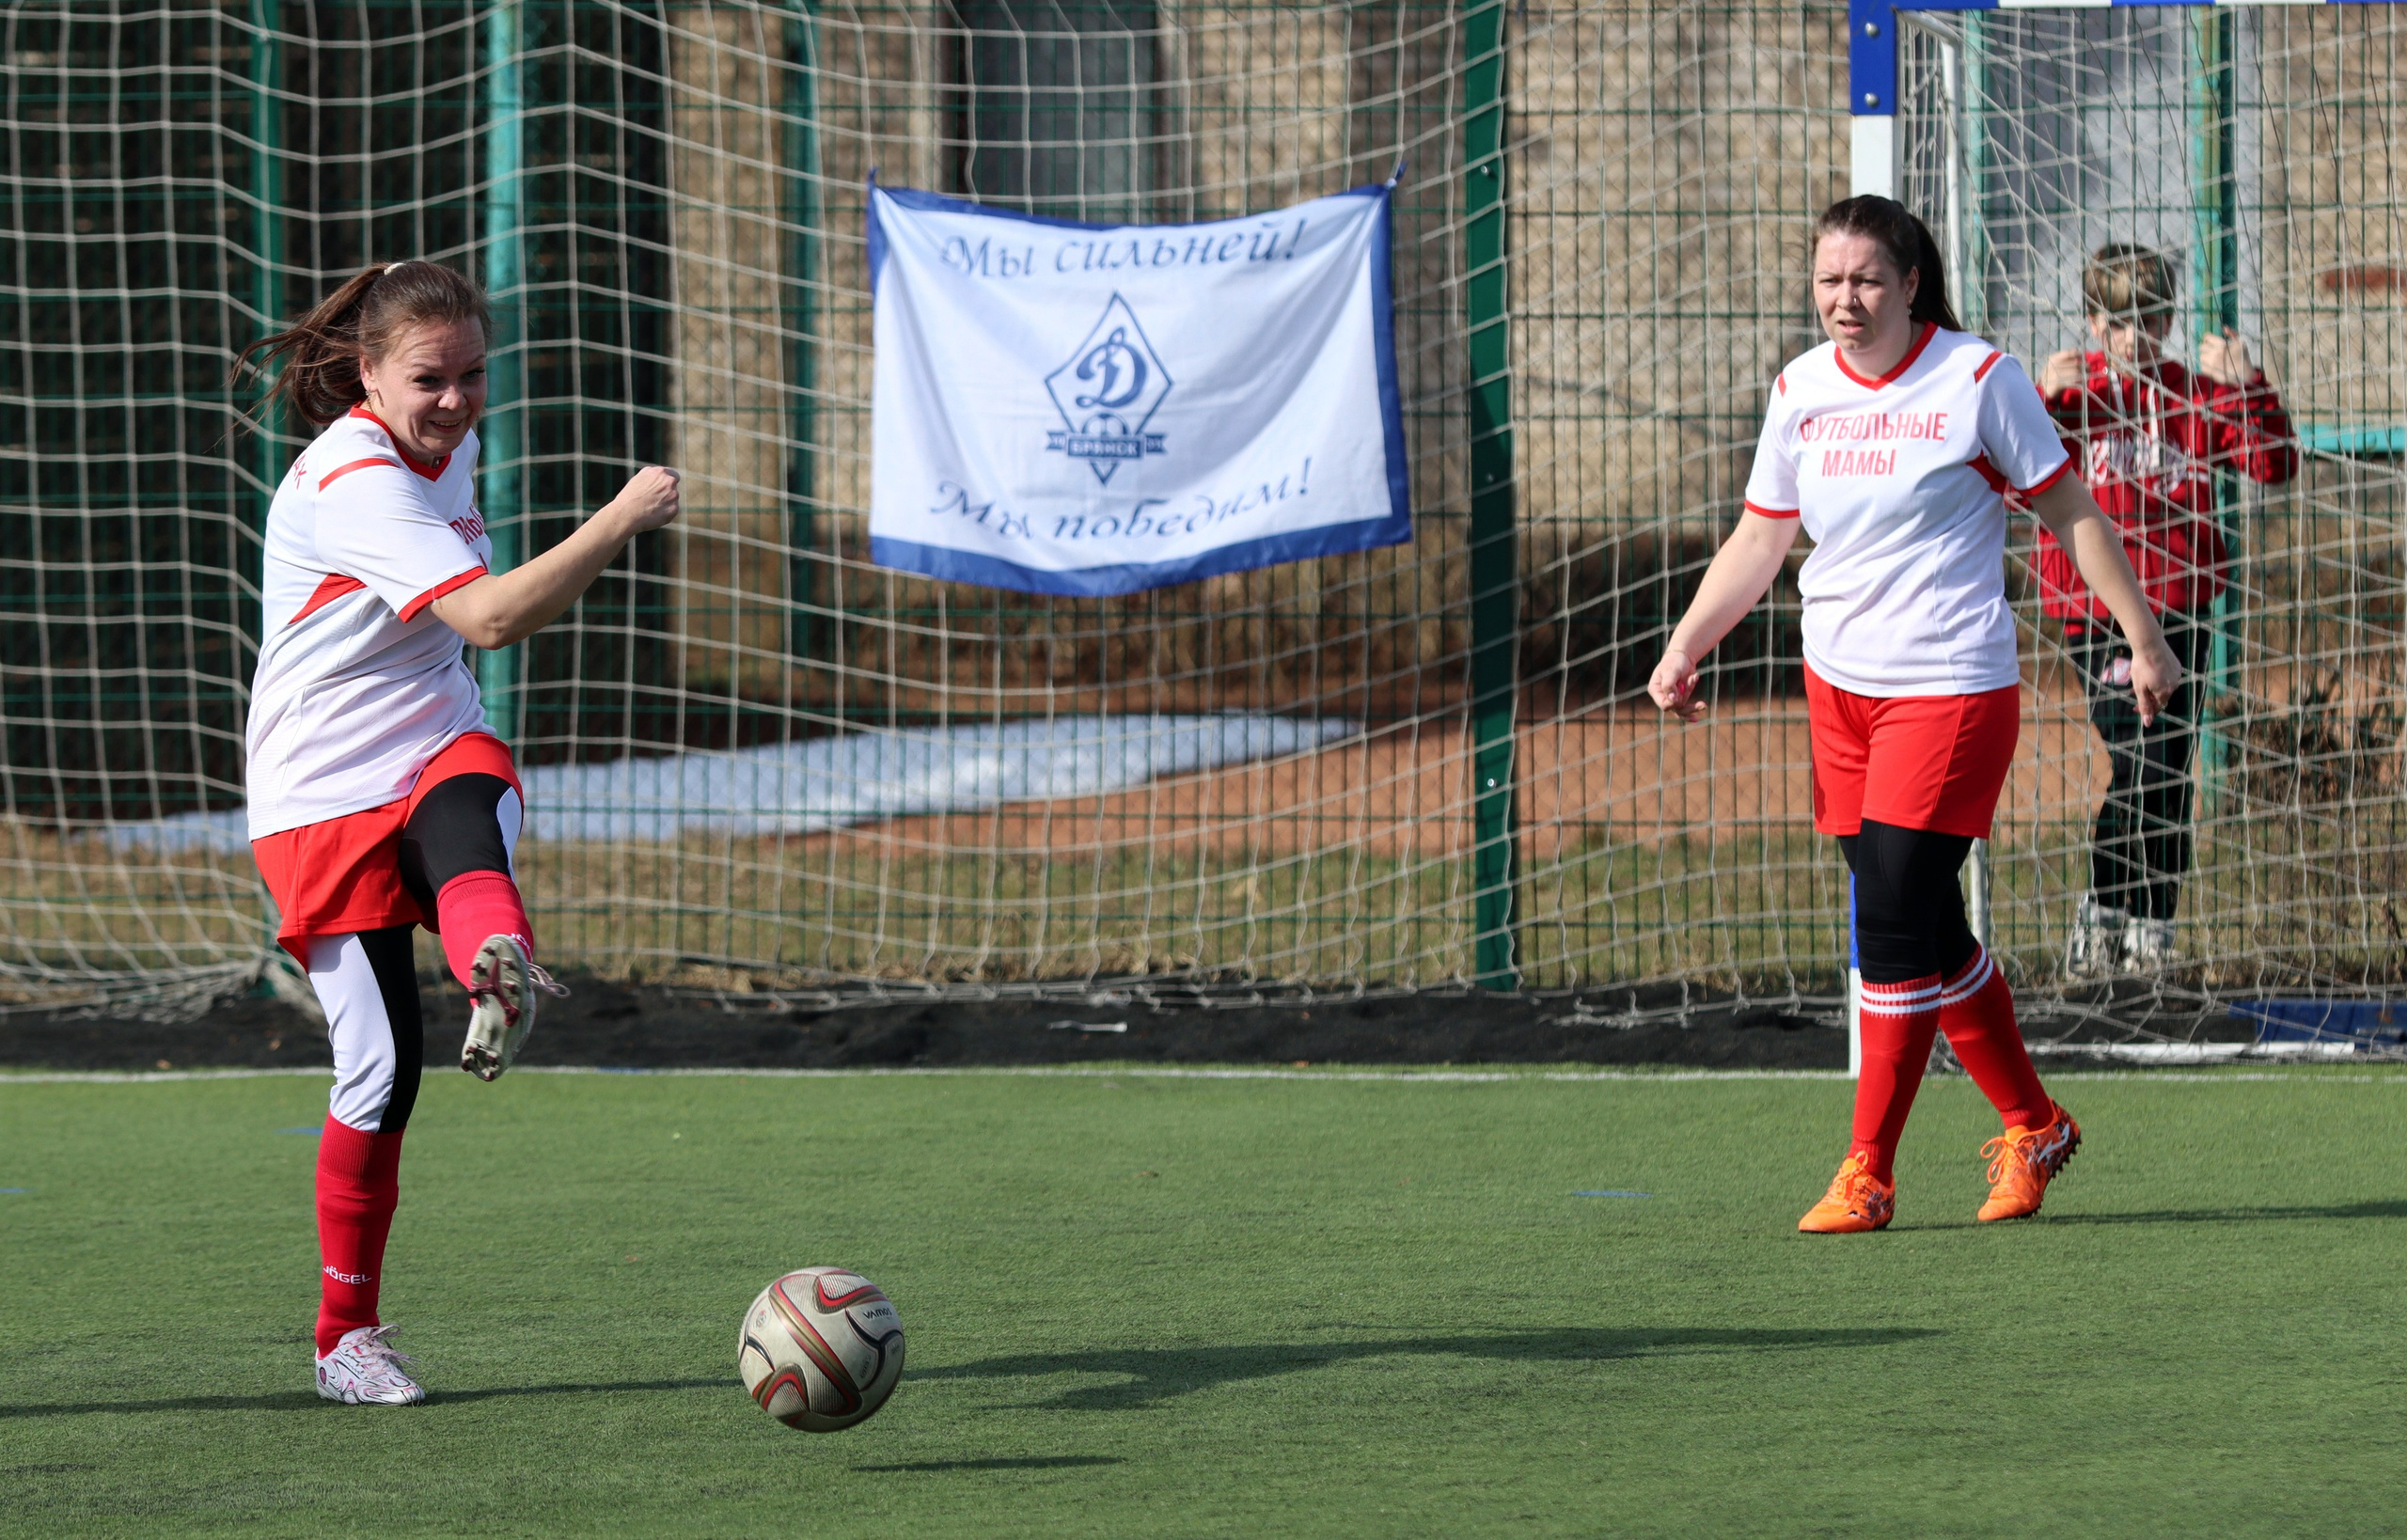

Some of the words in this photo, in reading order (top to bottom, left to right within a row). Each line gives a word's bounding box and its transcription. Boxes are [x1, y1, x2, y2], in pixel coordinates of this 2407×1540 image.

[941, 235, 1033, 276] Мы
[1056, 218, 1307, 273] сильней!
[1800, 412, 1948, 443] ФУТБОЛЬНЫЕ
[1821, 448, 1896, 478] МАМЫ
[930, 479, 1034, 541] Мы
[1054, 457, 1312, 539] победим!
